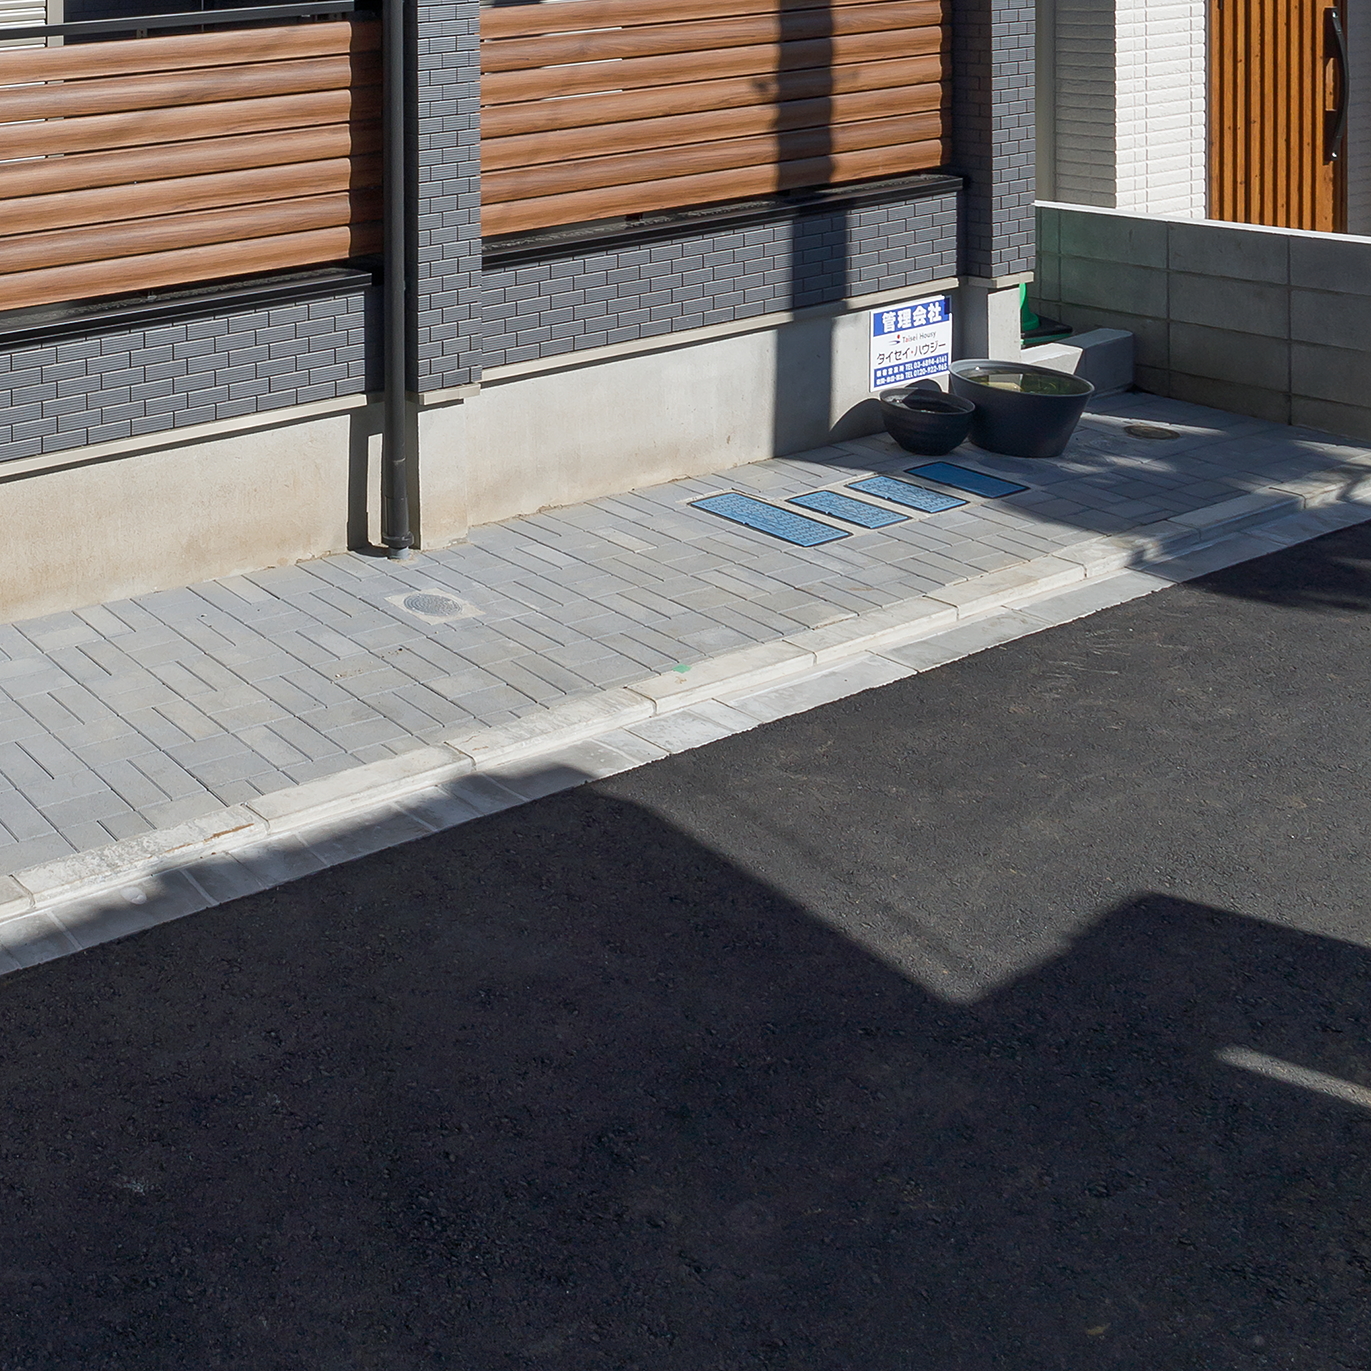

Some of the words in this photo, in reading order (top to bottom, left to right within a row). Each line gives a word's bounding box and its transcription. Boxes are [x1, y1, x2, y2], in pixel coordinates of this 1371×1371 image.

[882, 302, 942, 333] 管理会社
[902, 333, 918, 344] Taisei
[877, 340, 946, 365] タイセイ・ハウジー
